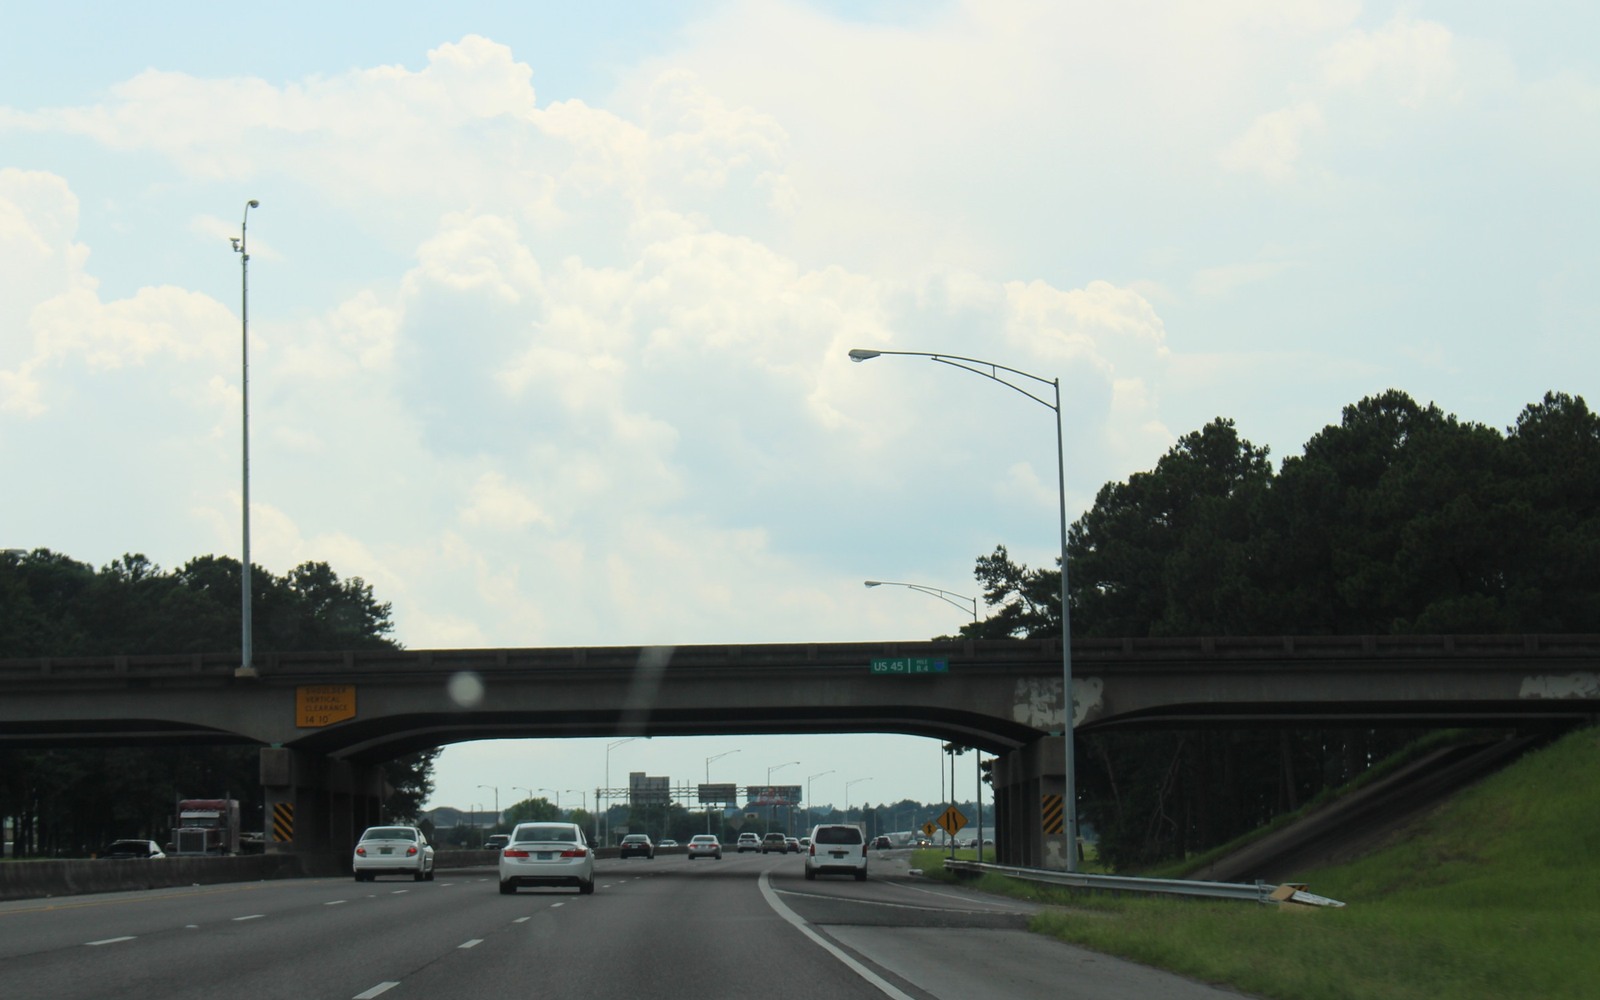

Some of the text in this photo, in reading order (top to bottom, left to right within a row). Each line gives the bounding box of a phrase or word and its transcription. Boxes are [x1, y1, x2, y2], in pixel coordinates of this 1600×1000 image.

[873, 661, 904, 672] US 45
[305, 704, 347, 712] CLEARANCE
